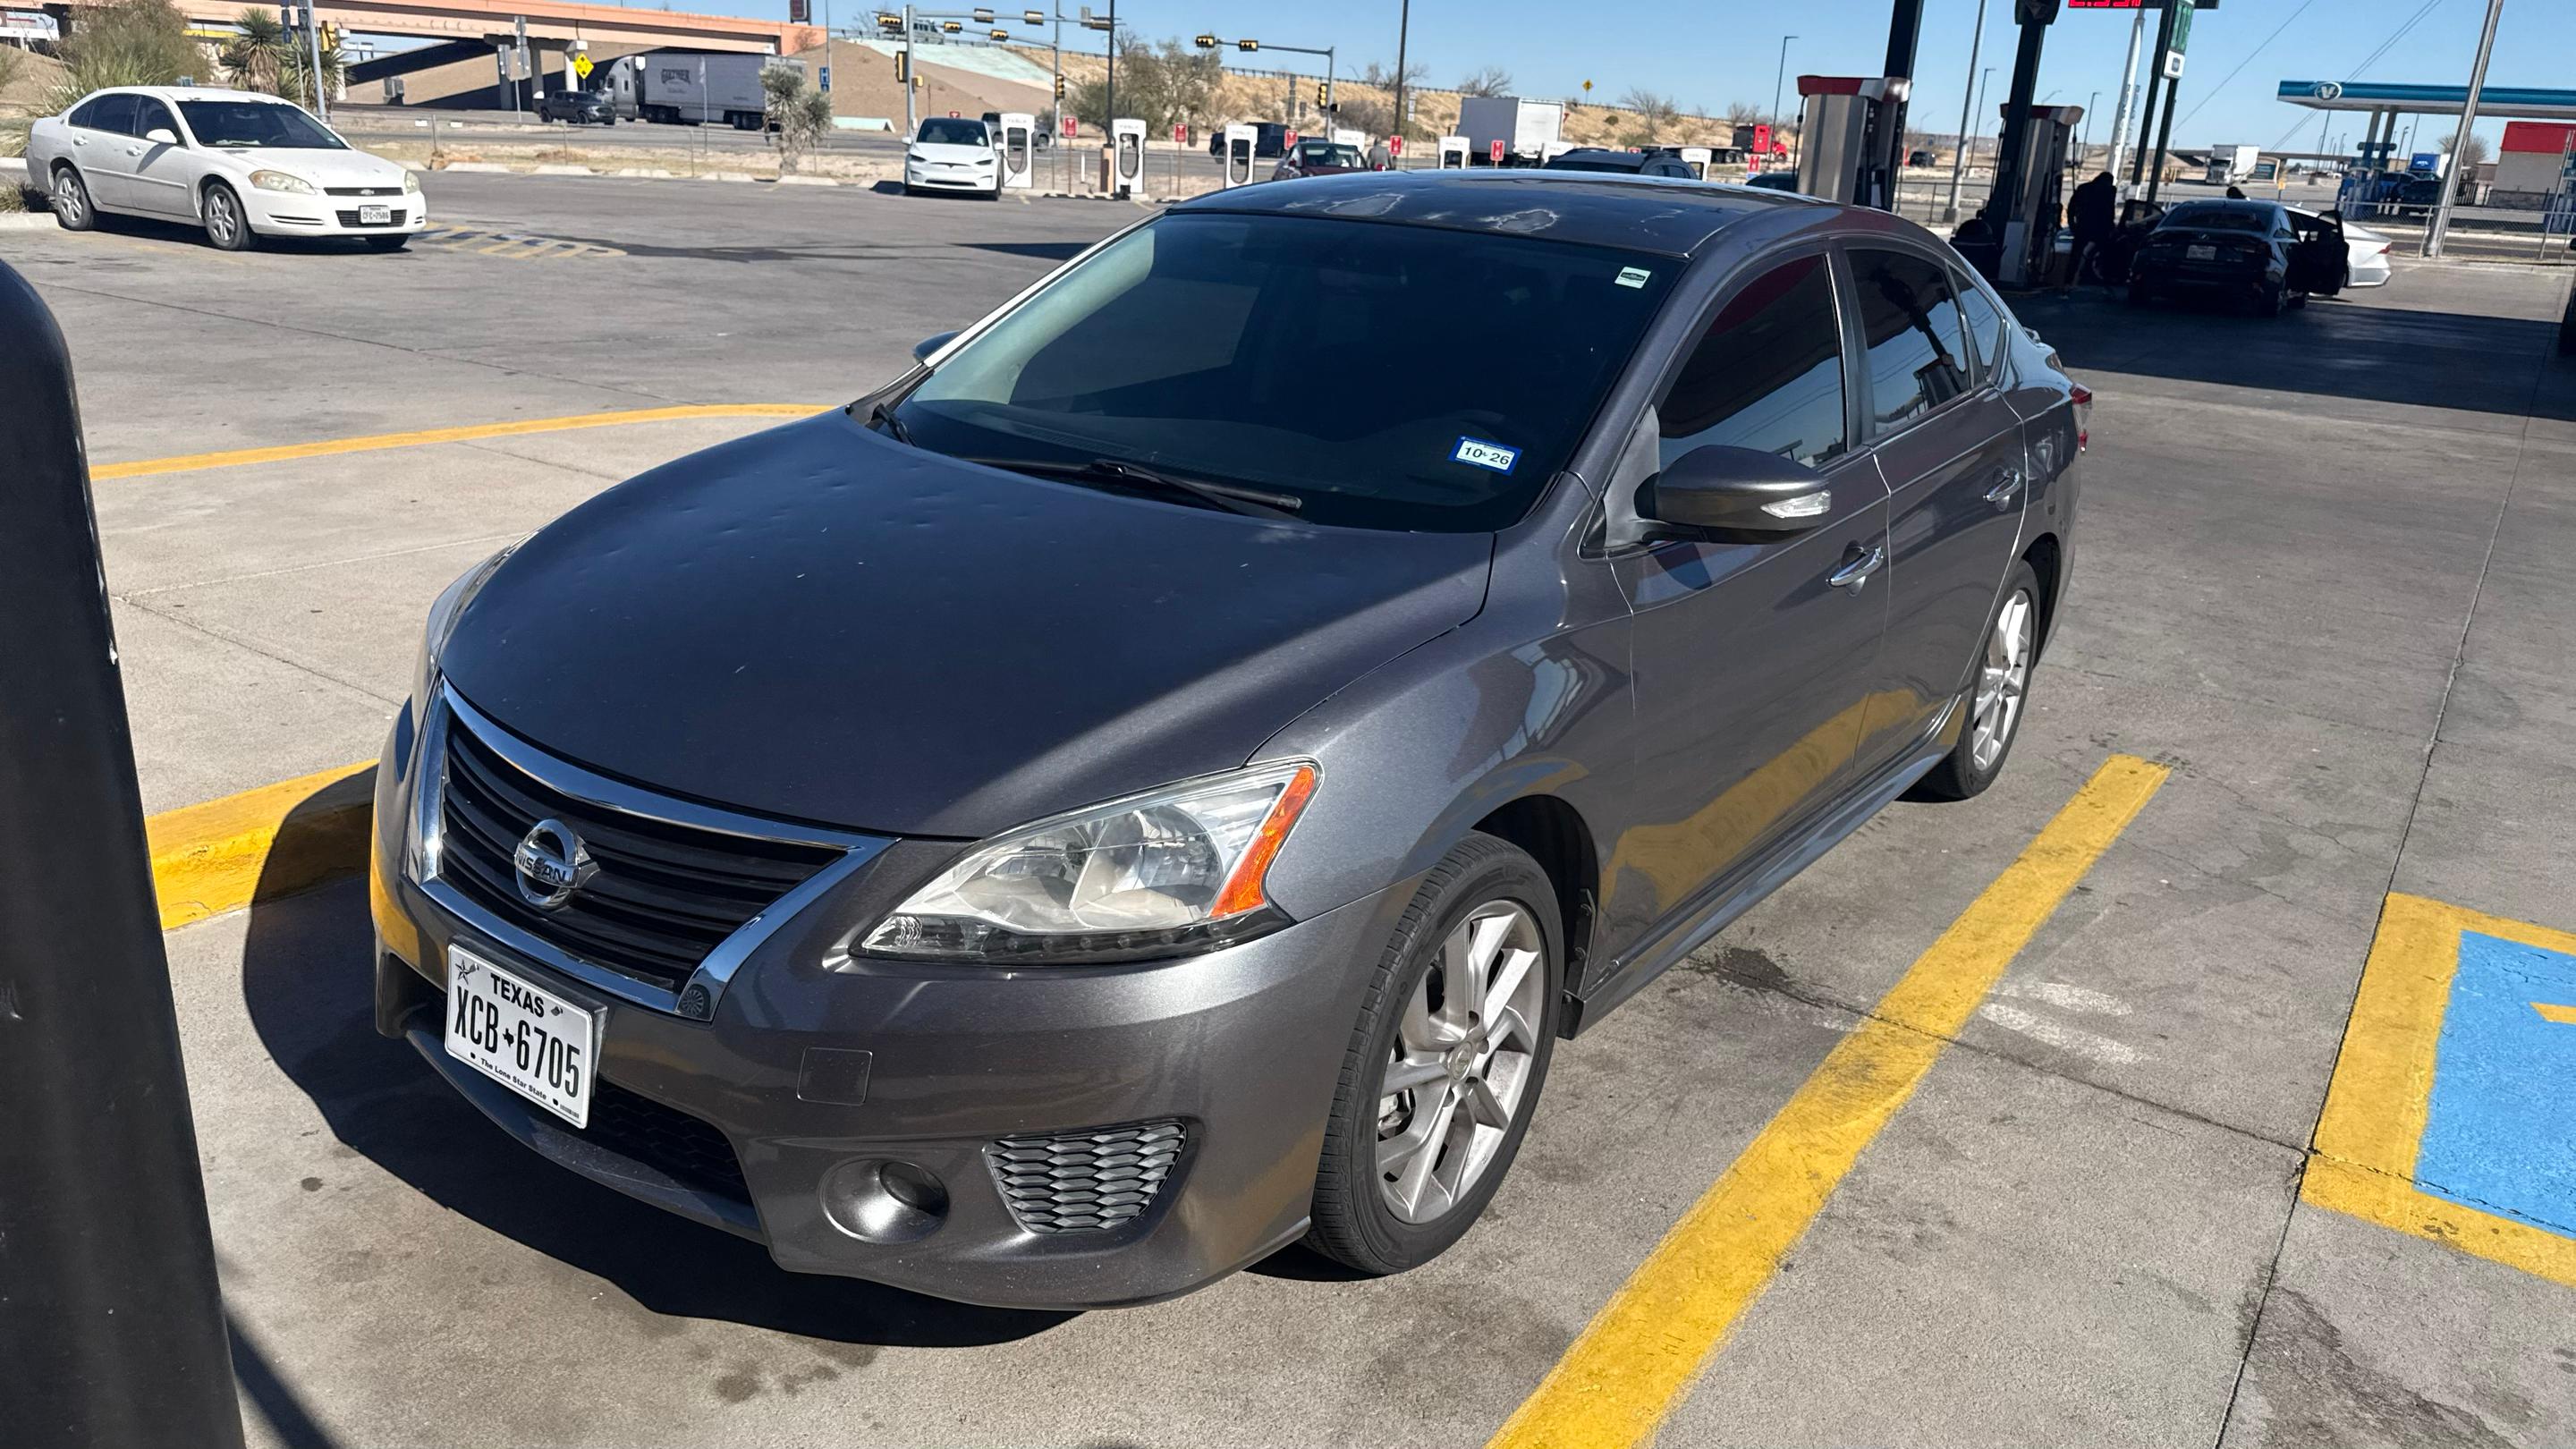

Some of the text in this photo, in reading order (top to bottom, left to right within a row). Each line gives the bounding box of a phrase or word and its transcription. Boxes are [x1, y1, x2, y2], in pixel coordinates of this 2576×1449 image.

[1489, 453, 1511, 465] 26
[516, 852, 567, 884] NISSAN
[491, 972, 545, 1018] TEXAS
[480, 1057, 547, 1101] The Lone Star State
